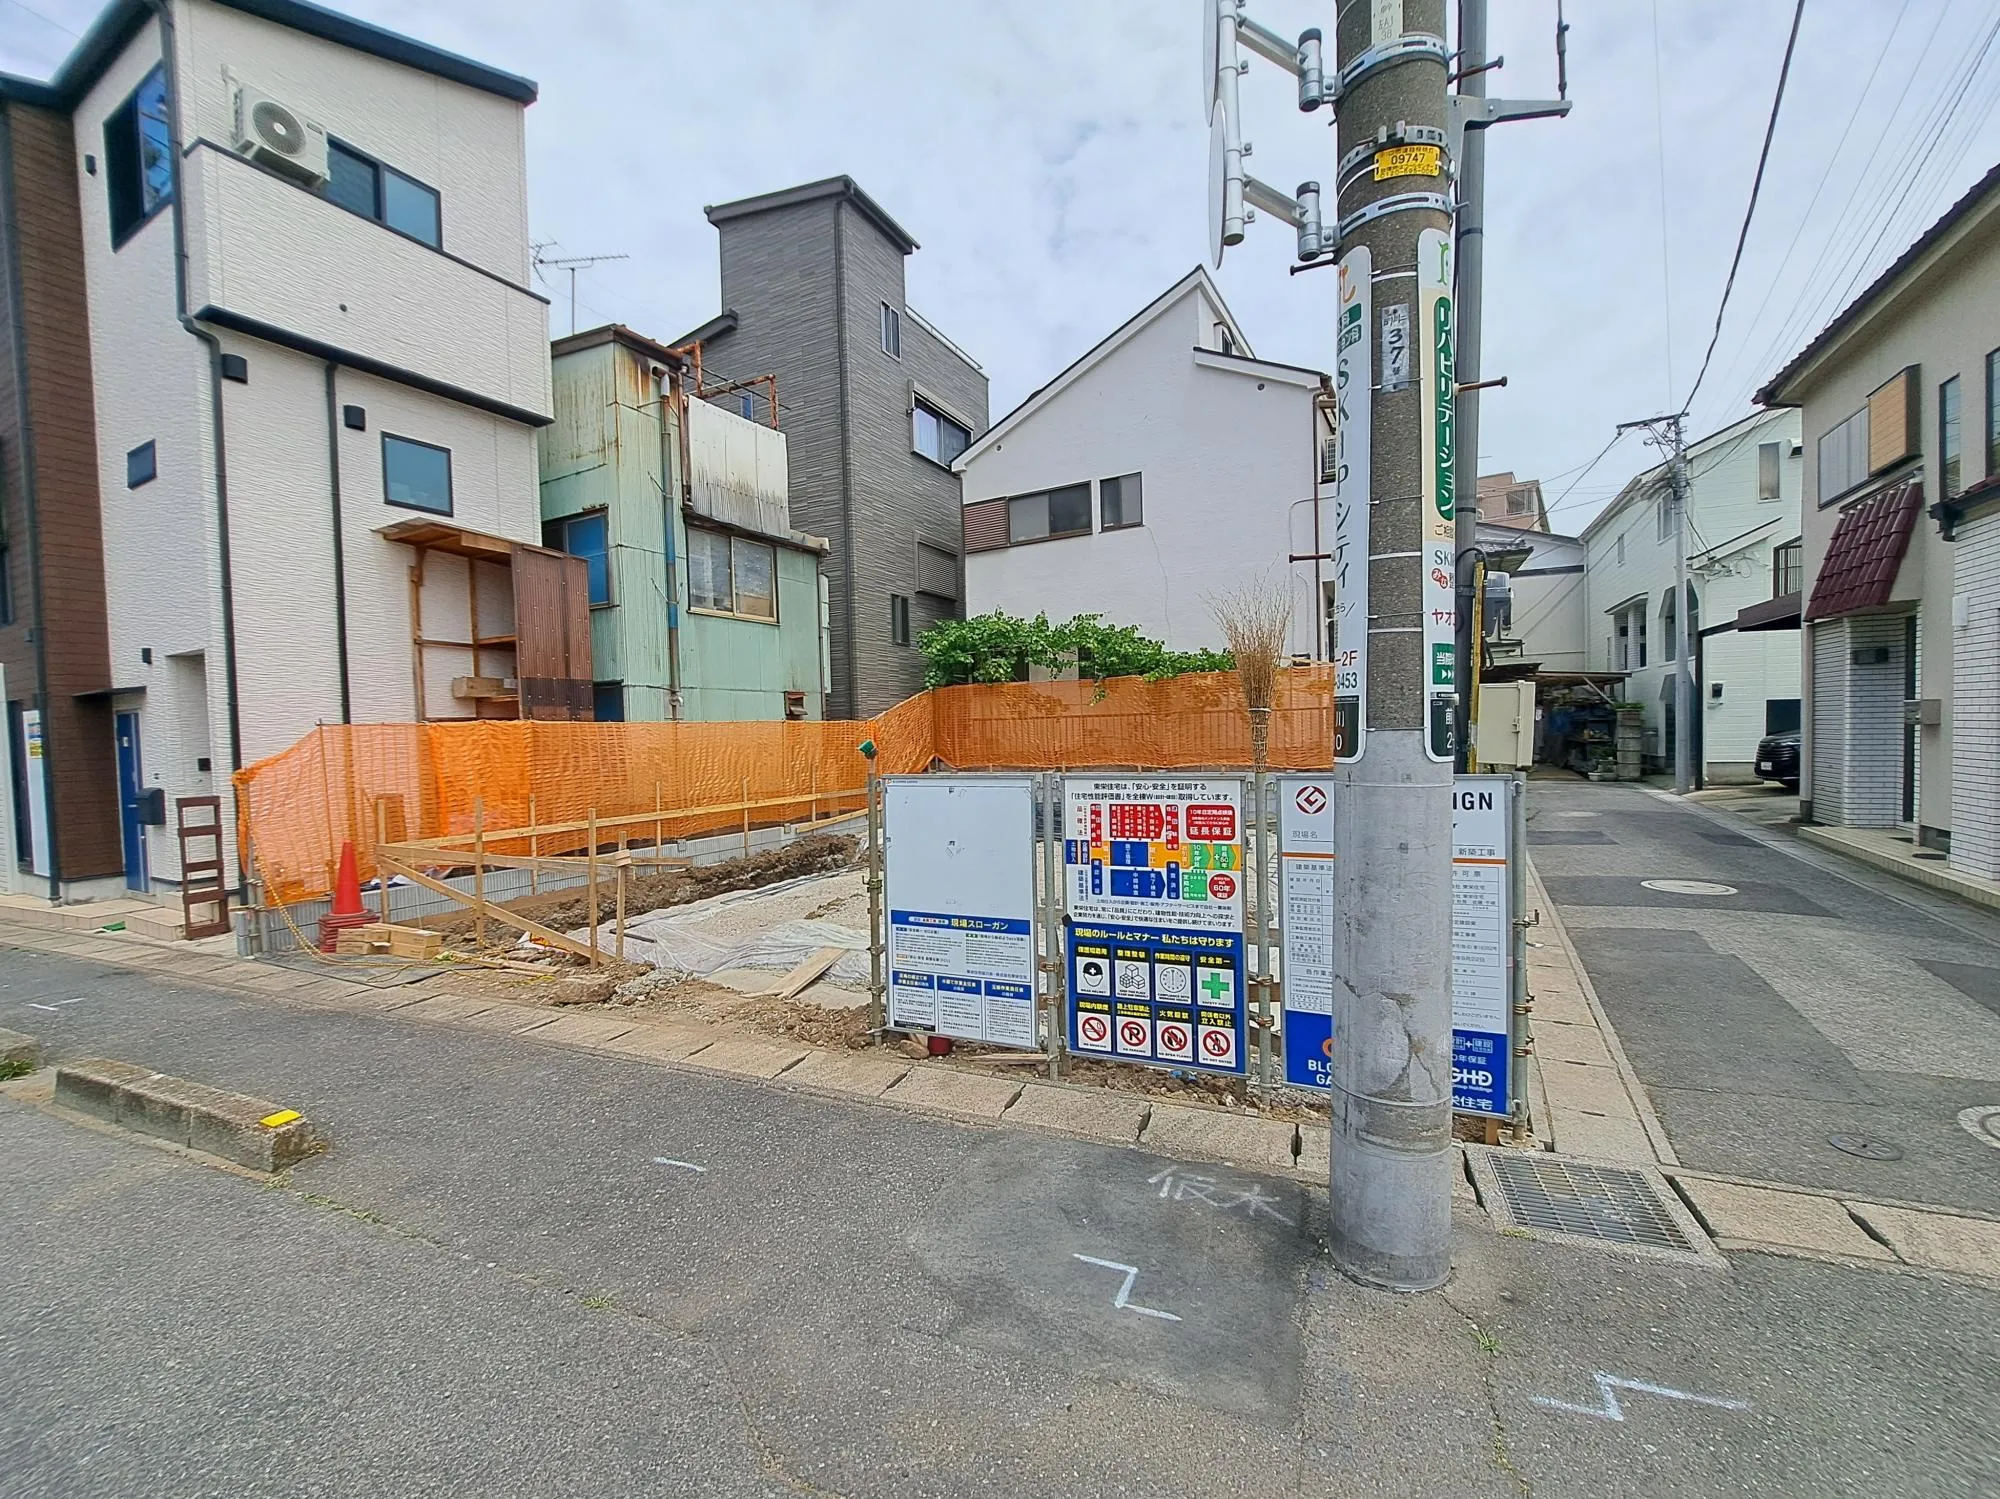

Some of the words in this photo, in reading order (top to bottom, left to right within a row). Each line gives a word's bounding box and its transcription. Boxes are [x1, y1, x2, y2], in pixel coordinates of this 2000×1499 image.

[1391, 153, 1426, 165] 09747
[1190, 826, 1233, 836] 延長保証
[1458, 848, 1496, 856] 新築工事
[951, 918, 1008, 930] 現場スローガン
[1075, 928, 1159, 941] 現場のルールとマナー
[1162, 934, 1234, 948] 私たちは守ります
